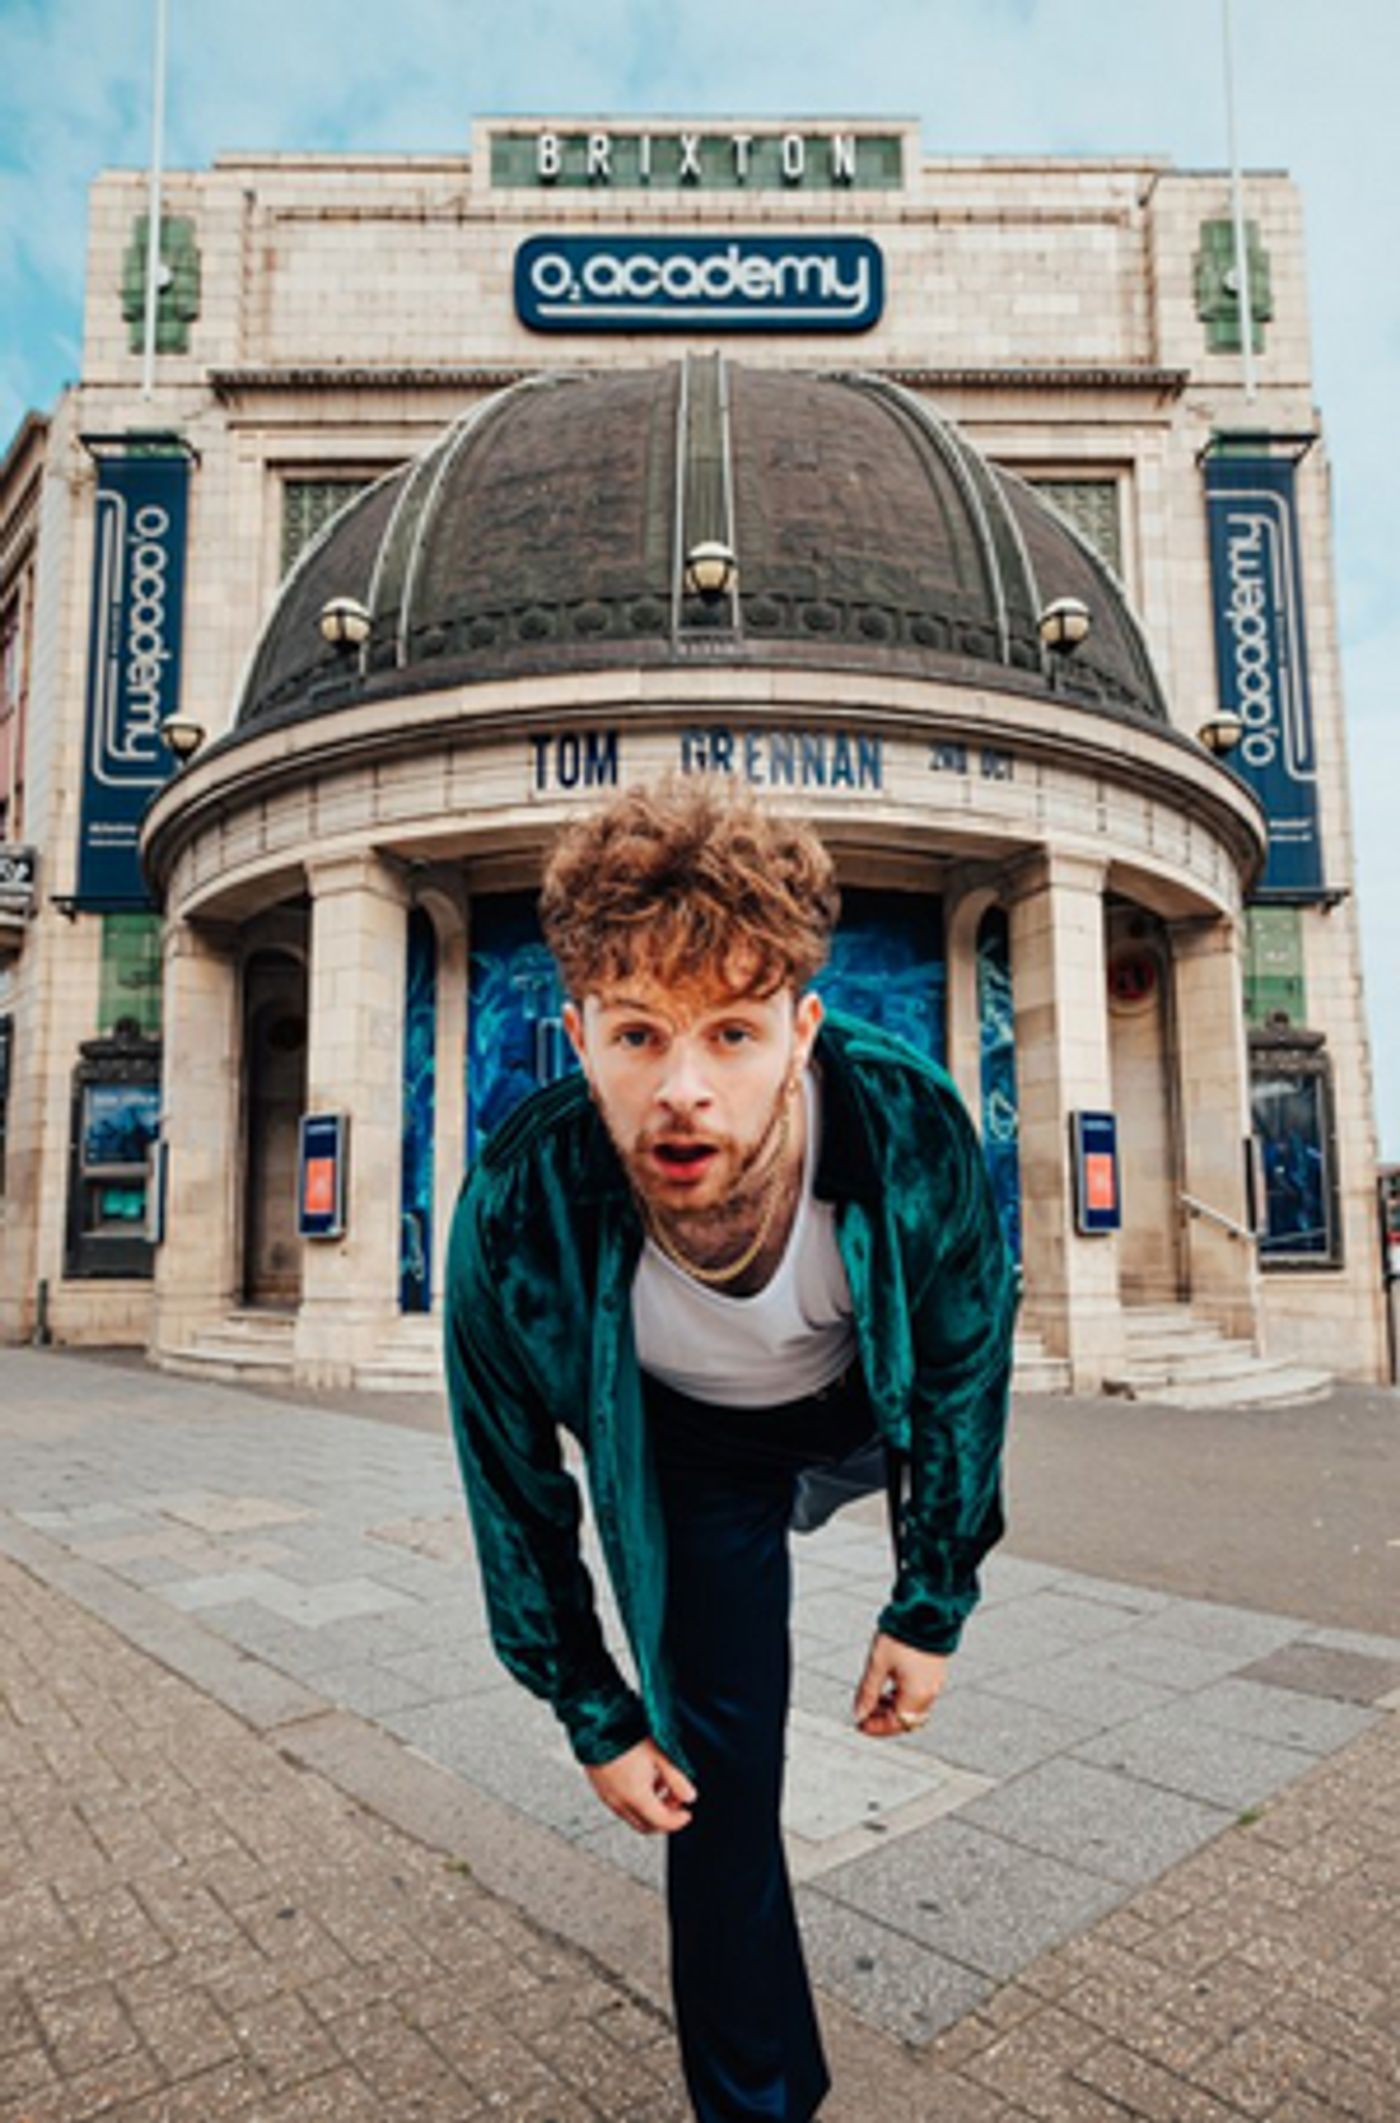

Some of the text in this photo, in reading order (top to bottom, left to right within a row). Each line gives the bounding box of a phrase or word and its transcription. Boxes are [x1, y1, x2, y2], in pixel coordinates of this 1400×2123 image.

[537, 133, 857, 178] BRIXTON
[530, 729, 620, 791] TOM
[680, 727, 883, 790] GRENNAN
